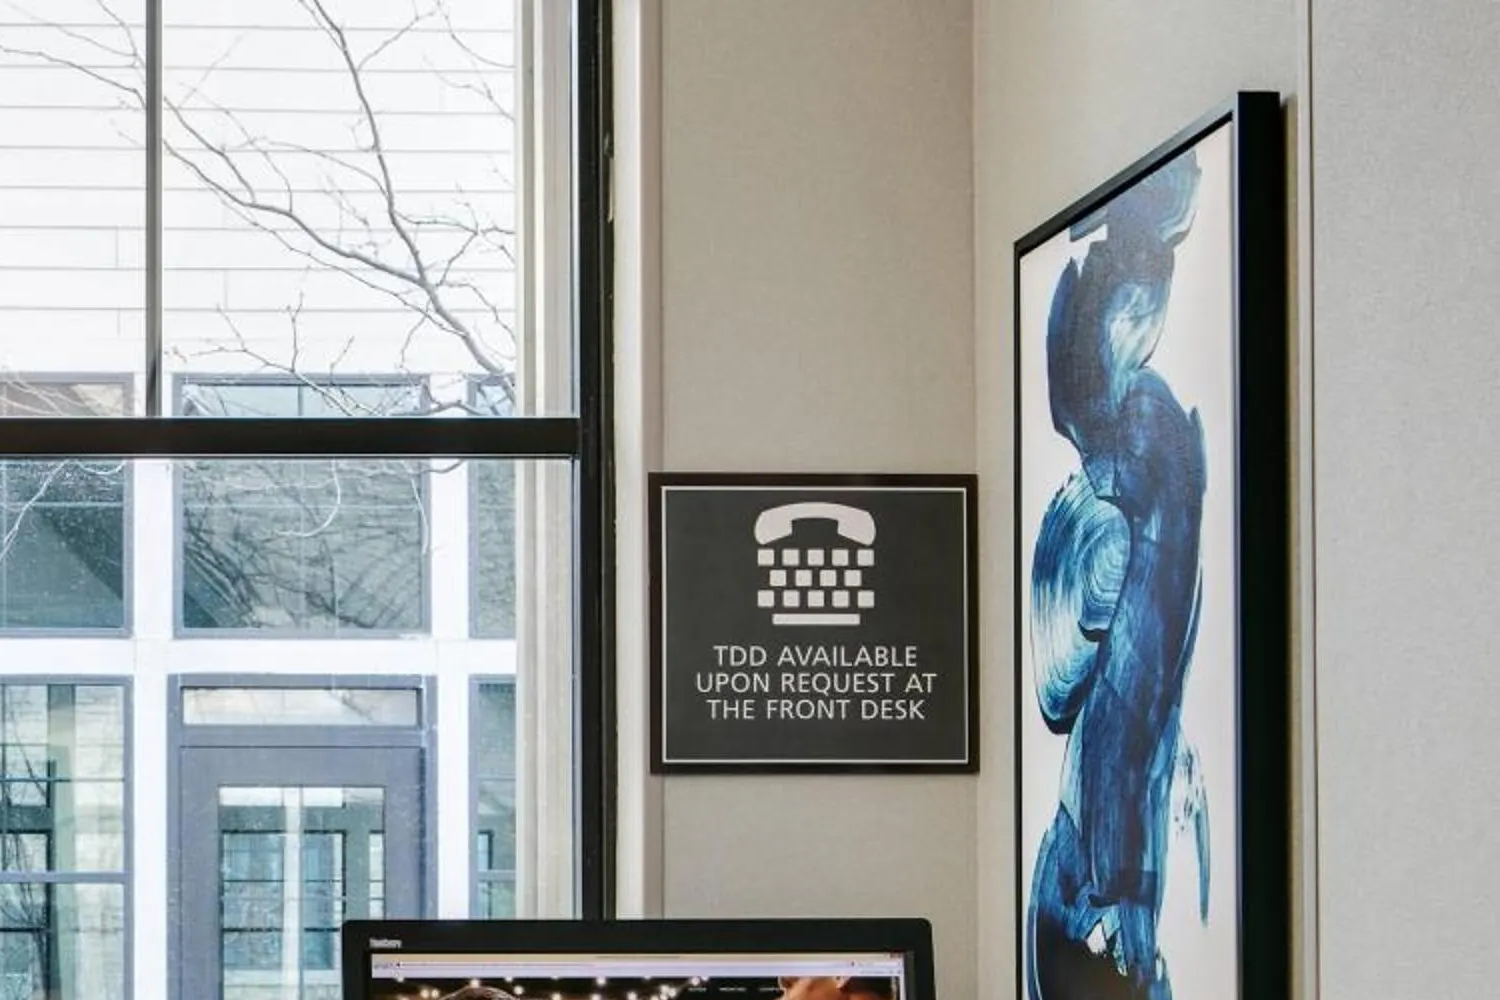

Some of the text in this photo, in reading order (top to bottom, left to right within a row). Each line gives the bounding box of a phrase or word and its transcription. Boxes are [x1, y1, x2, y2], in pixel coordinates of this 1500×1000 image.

[713, 646, 916, 666] TDD AVAILABLE
[697, 672, 937, 696] UPON REQUEST AT
[706, 700, 924, 720] THE FRONT DESK
